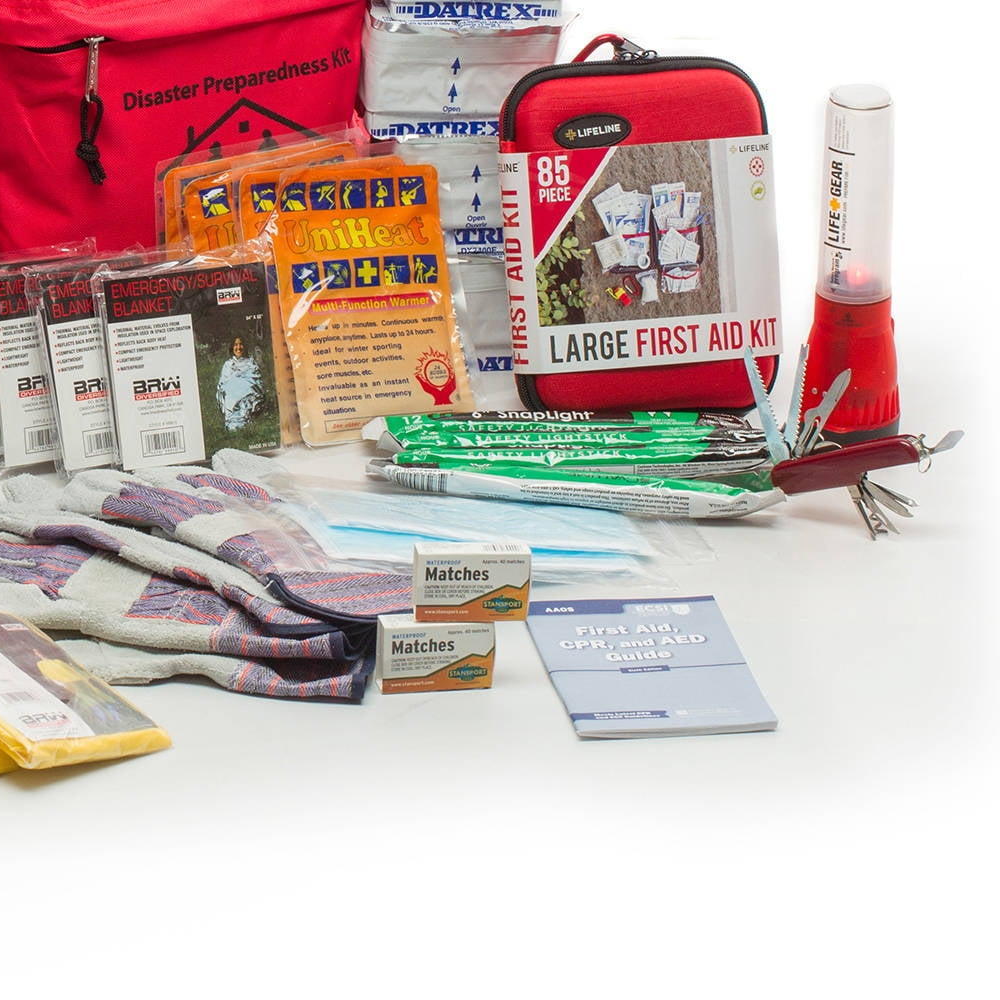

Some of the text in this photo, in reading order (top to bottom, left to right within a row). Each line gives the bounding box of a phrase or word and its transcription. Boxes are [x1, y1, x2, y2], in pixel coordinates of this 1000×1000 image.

[414, 1, 541, 21] DATREX
[123, 48, 352, 111] Disaster Preparedness Kit
[443, 105, 461, 113] Open
[577, 123, 621, 138] LIFELINE
[739, 143, 769, 153] LIFELINE
[537, 155, 570, 187] 85
[830, 160, 843, 197] GEAR
[539, 187, 571, 203] PIECE
[827, 210, 841, 243] LIFE
[285, 217, 428, 254] UniHeat
[500, 185, 528, 365] FIRST AID KIT
[110, 268, 258, 299] EMERGENCY/SURVIVAL
[113, 296, 173, 318] BLANKET
[312, 296, 430, 313] Multi-Function Warmer
[381, 318, 418, 327] Continuous
[371, 331, 388, 339] Lasts
[550, 318, 777, 363] LARGE FIRST AID KIT
[372, 343, 402, 352] sporting
[315, 360, 341, 368] events,
[133, 375, 180, 394] BRW
[318, 382, 356, 391] Invaluable
[384, 378, 410, 386] instant
[321, 395, 338, 403] heat
[374, 390, 412, 399] emergency
[402, 415, 423, 425] 12
[425, 566, 489, 581] Matches
[575, 623, 680, 636] First Aid,
[391, 639, 455, 655] Matches
[560, 634, 706, 651] CPR, and AED
[606, 650, 673, 662] Guide
[450, 669, 487, 677] STANSPORT
